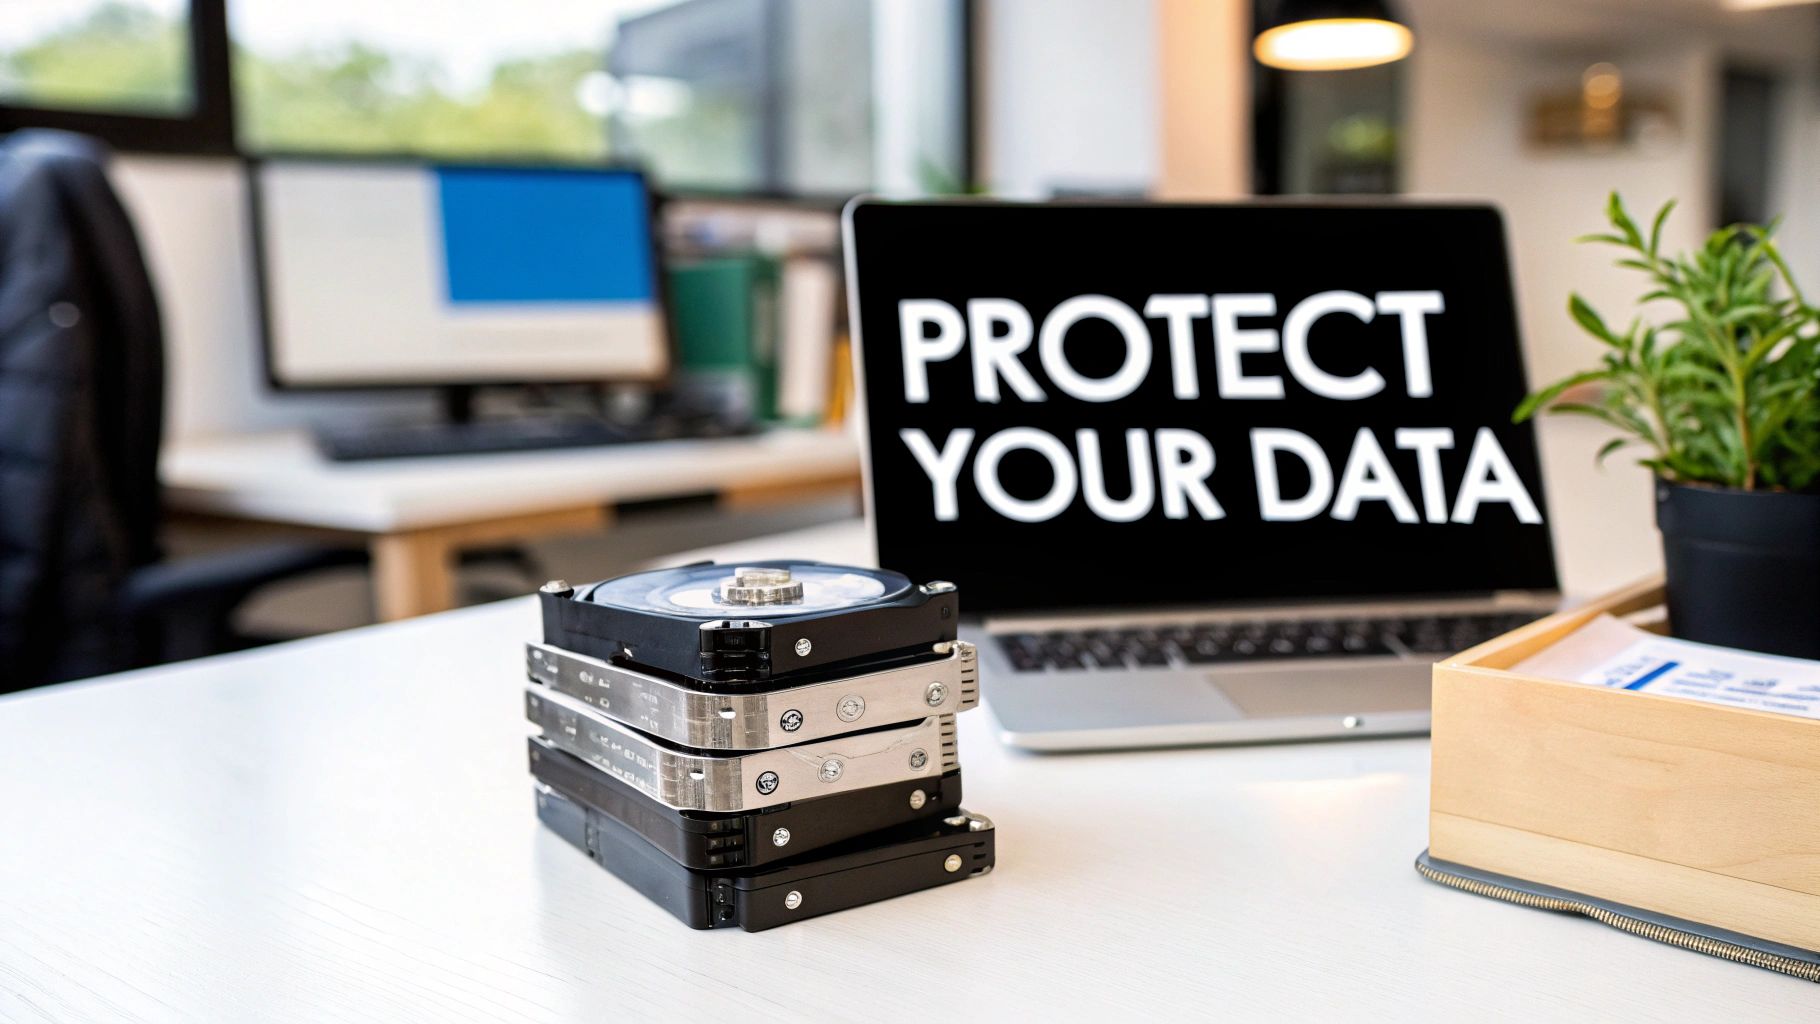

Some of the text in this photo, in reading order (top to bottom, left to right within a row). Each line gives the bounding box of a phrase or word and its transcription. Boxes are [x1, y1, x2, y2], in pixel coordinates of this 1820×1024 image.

[899, 290, 1444, 403] PROTECT
[900, 426, 1543, 525] YOUR DATA
